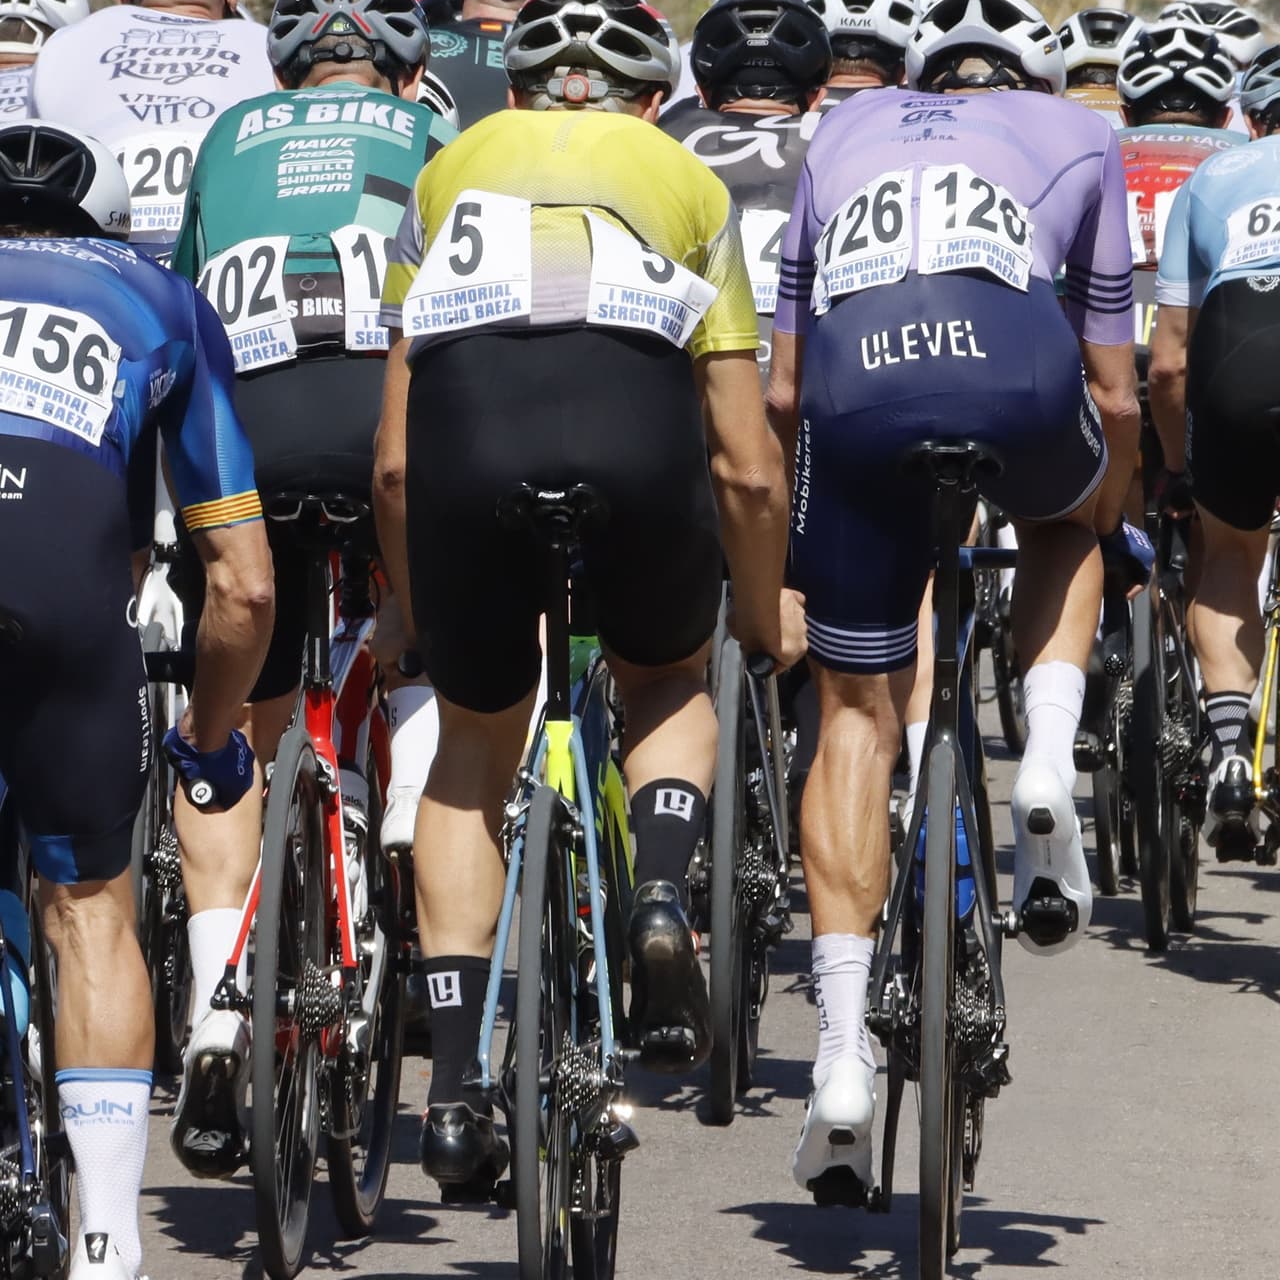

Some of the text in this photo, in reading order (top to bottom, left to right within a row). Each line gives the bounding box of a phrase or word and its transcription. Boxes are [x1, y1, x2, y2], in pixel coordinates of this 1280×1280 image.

[99, 45, 240, 65] Granja
[109, 58, 230, 85] Rinya
[236, 102, 416, 142] AS BIKE
[279, 149, 355, 161] ORBEA
[280, 137, 357, 151] MAVIC
[277, 172, 352, 187] SHIMANO
[278, 159, 354, 175] PIRELLI
[277, 183, 351, 199] SRAM
[823, 180, 904, 267] 126
[448, 201, 483, 277] 5
[947, 238, 1016, 266] MEMORIAL
[986, 255, 1021, 285] BAEZA
[301, 297, 344, 317] BIKE
[431, 283, 512, 311] MEMORIAL
[412, 297, 522, 332] SERGIO BAEZA
[597, 303, 657, 326] SERGIO
[242, 341, 289, 364] BAEZA
[0, 369, 91, 416] MEMORIAL
[41, 401, 96, 437] BAEZA
